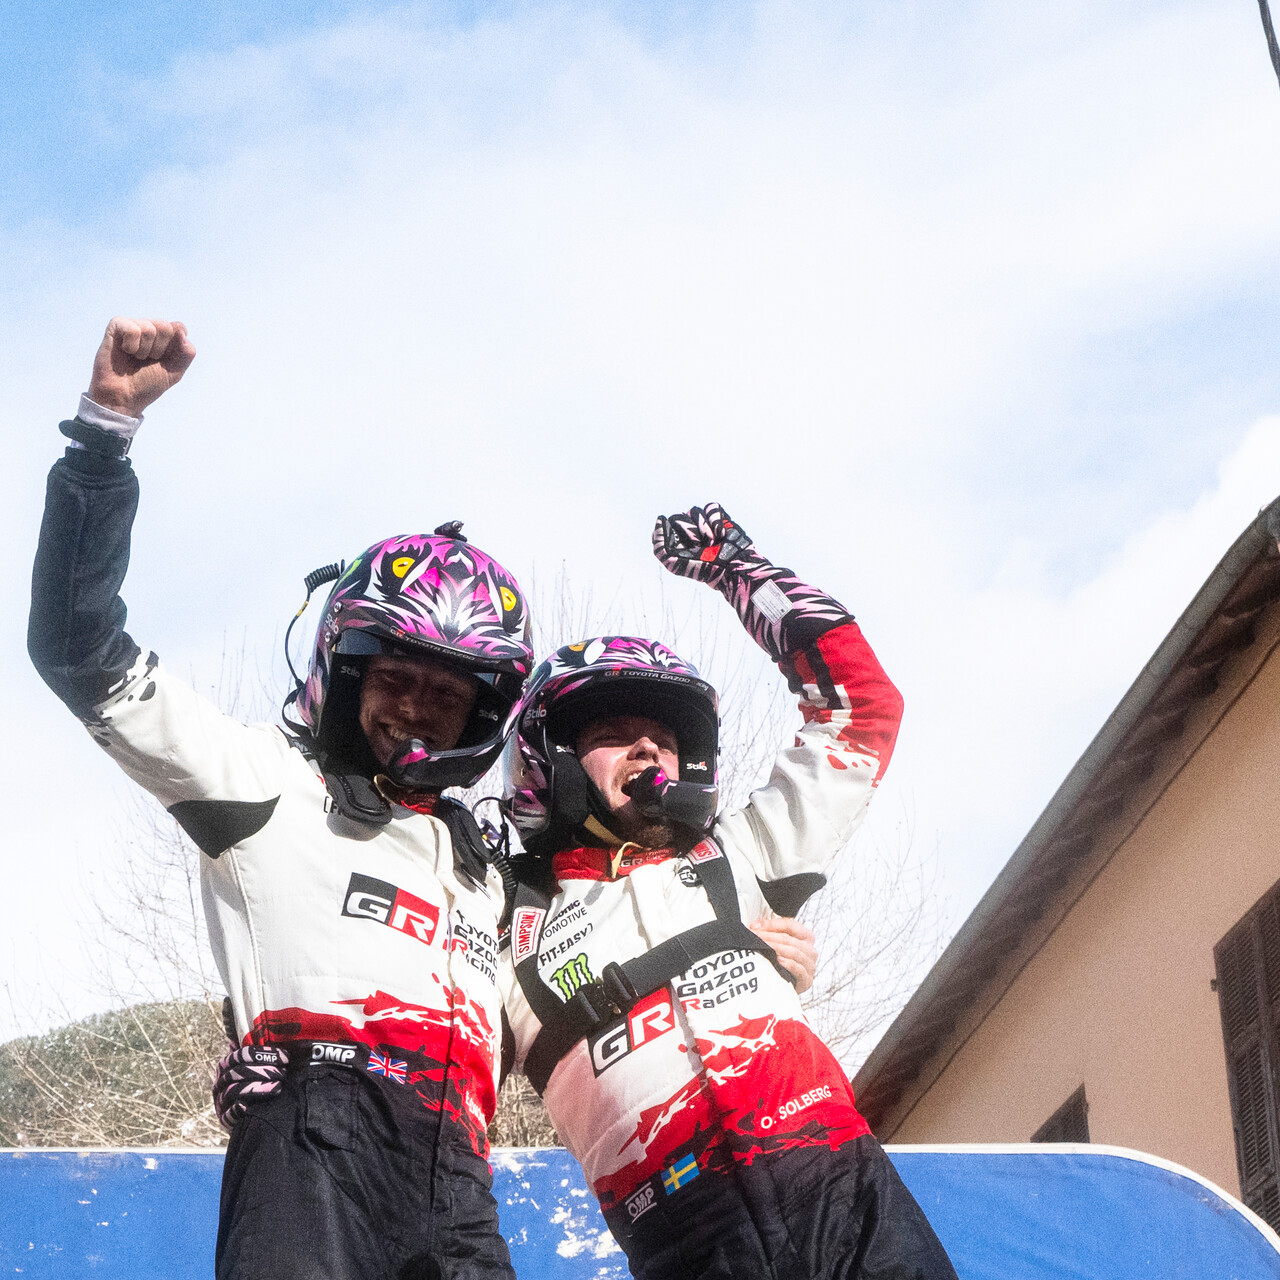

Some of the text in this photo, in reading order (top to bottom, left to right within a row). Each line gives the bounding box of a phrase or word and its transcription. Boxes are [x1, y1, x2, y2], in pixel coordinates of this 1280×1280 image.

[622, 670, 659, 679] TOYOTA
[346, 891, 436, 945] GR
[518, 912, 535, 955] SIMPSON
[676, 961, 757, 999] GAZOO
[679, 976, 758, 1012] Racing
[311, 1043, 357, 1064] OMP
[592, 1001, 672, 1072] GR
[254, 1053, 278, 1063] OMP
[760, 1084, 833, 1130] O. SOLBERG
[627, 1186, 655, 1218] OMP
